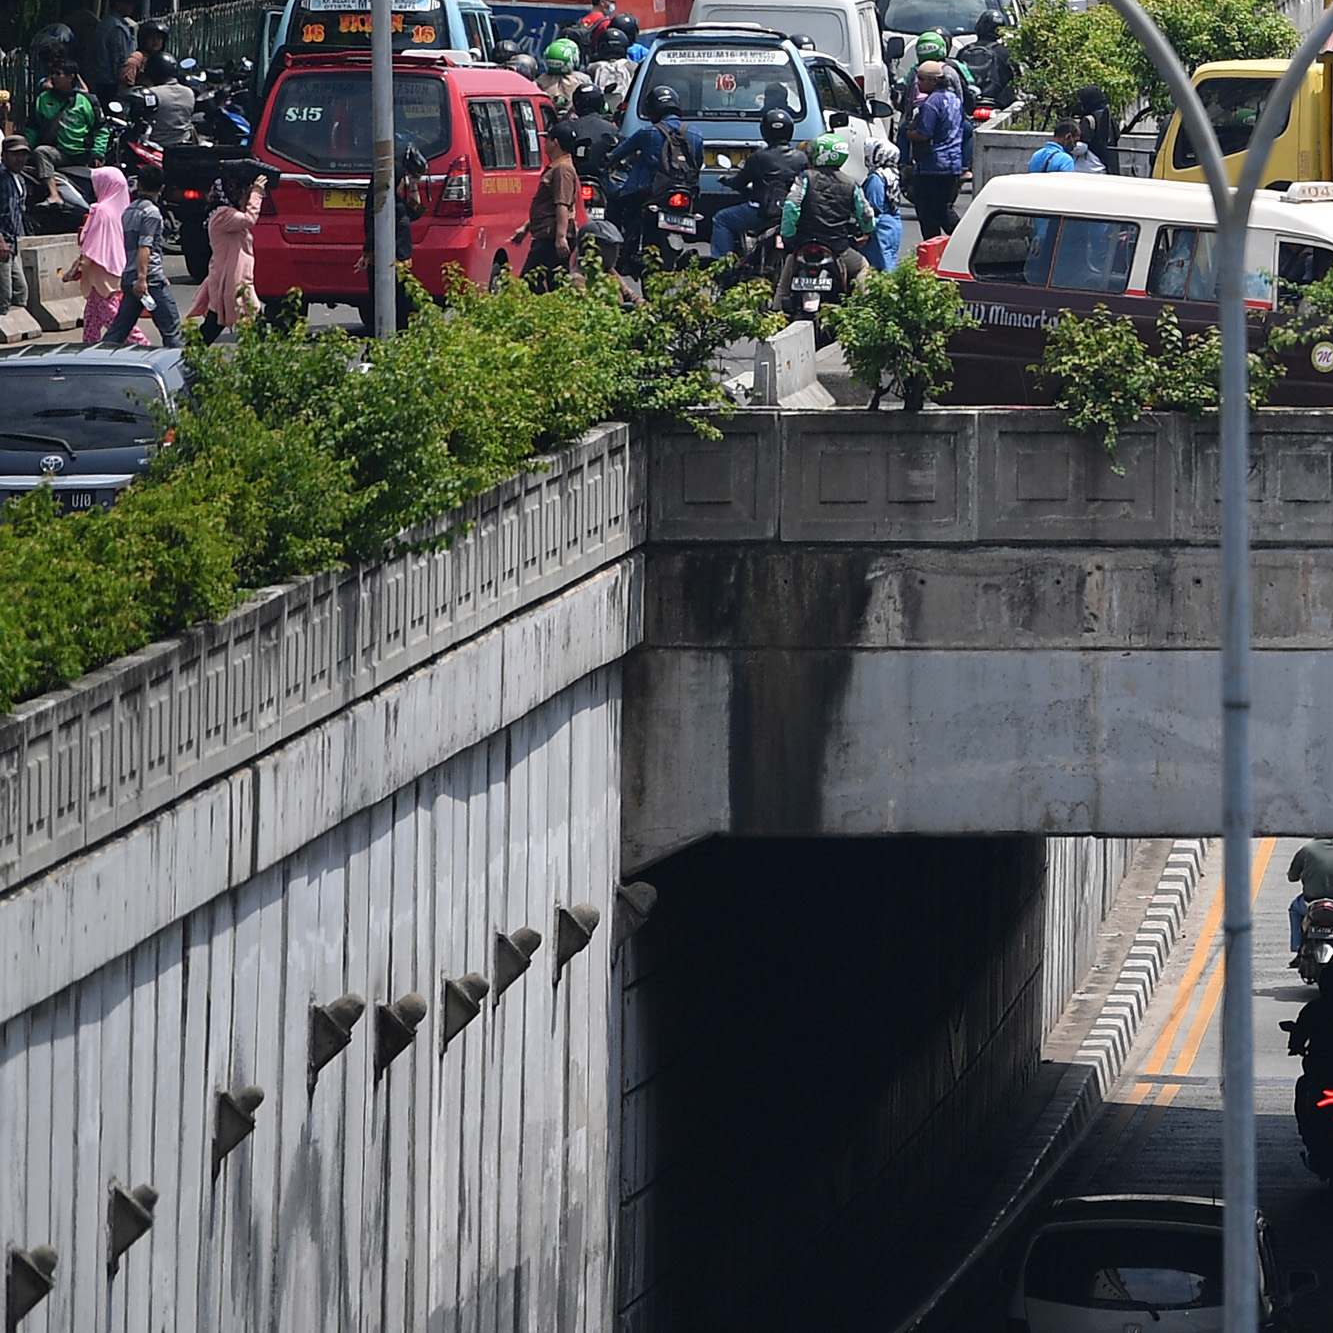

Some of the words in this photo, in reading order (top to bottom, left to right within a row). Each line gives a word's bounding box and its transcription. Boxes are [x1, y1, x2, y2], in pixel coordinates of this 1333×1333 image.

[302, 24, 325, 43] 16
[412, 25, 436, 44] 16
[715, 51, 735, 59] M16
[715, 73, 736, 93] 16
